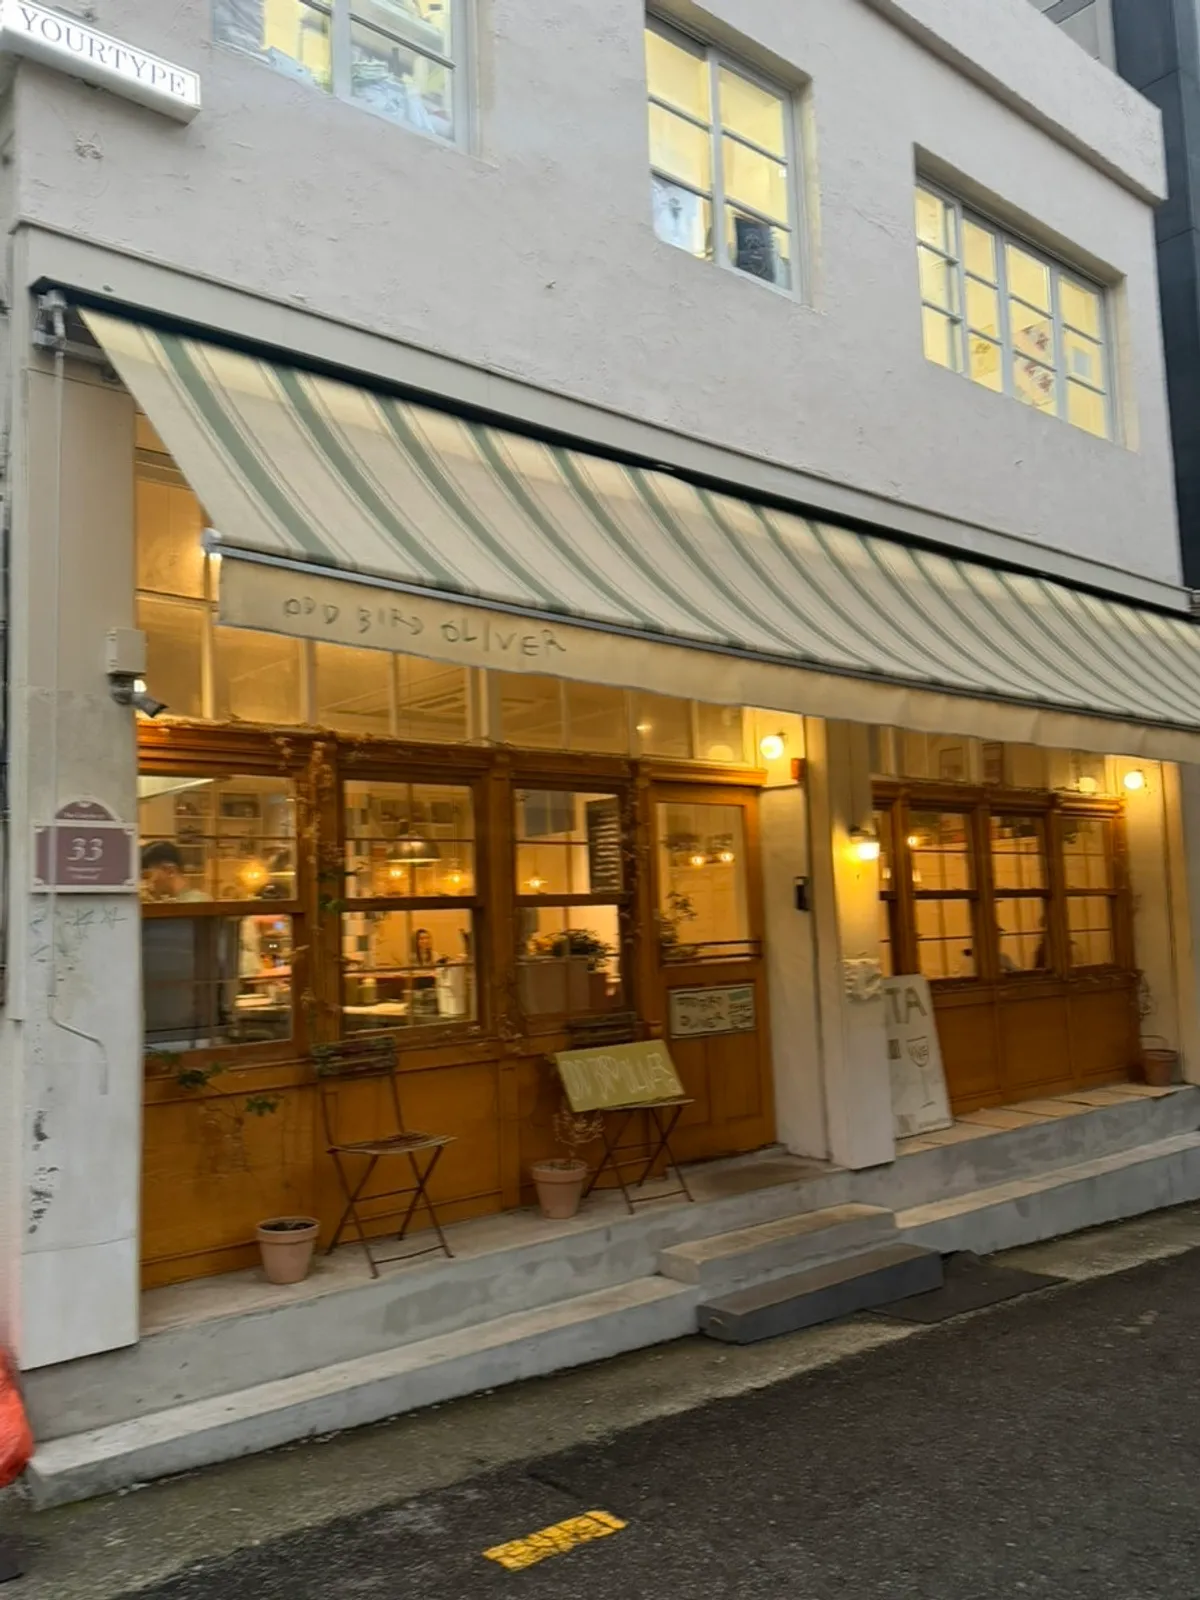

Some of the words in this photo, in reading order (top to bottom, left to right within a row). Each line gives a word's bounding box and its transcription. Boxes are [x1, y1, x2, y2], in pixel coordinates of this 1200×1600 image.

[20, 6, 186, 97] YOURTYPE
[283, 596, 340, 625] ODD
[440, 617, 567, 656] OLIVER
[65, 837, 104, 861] 33
